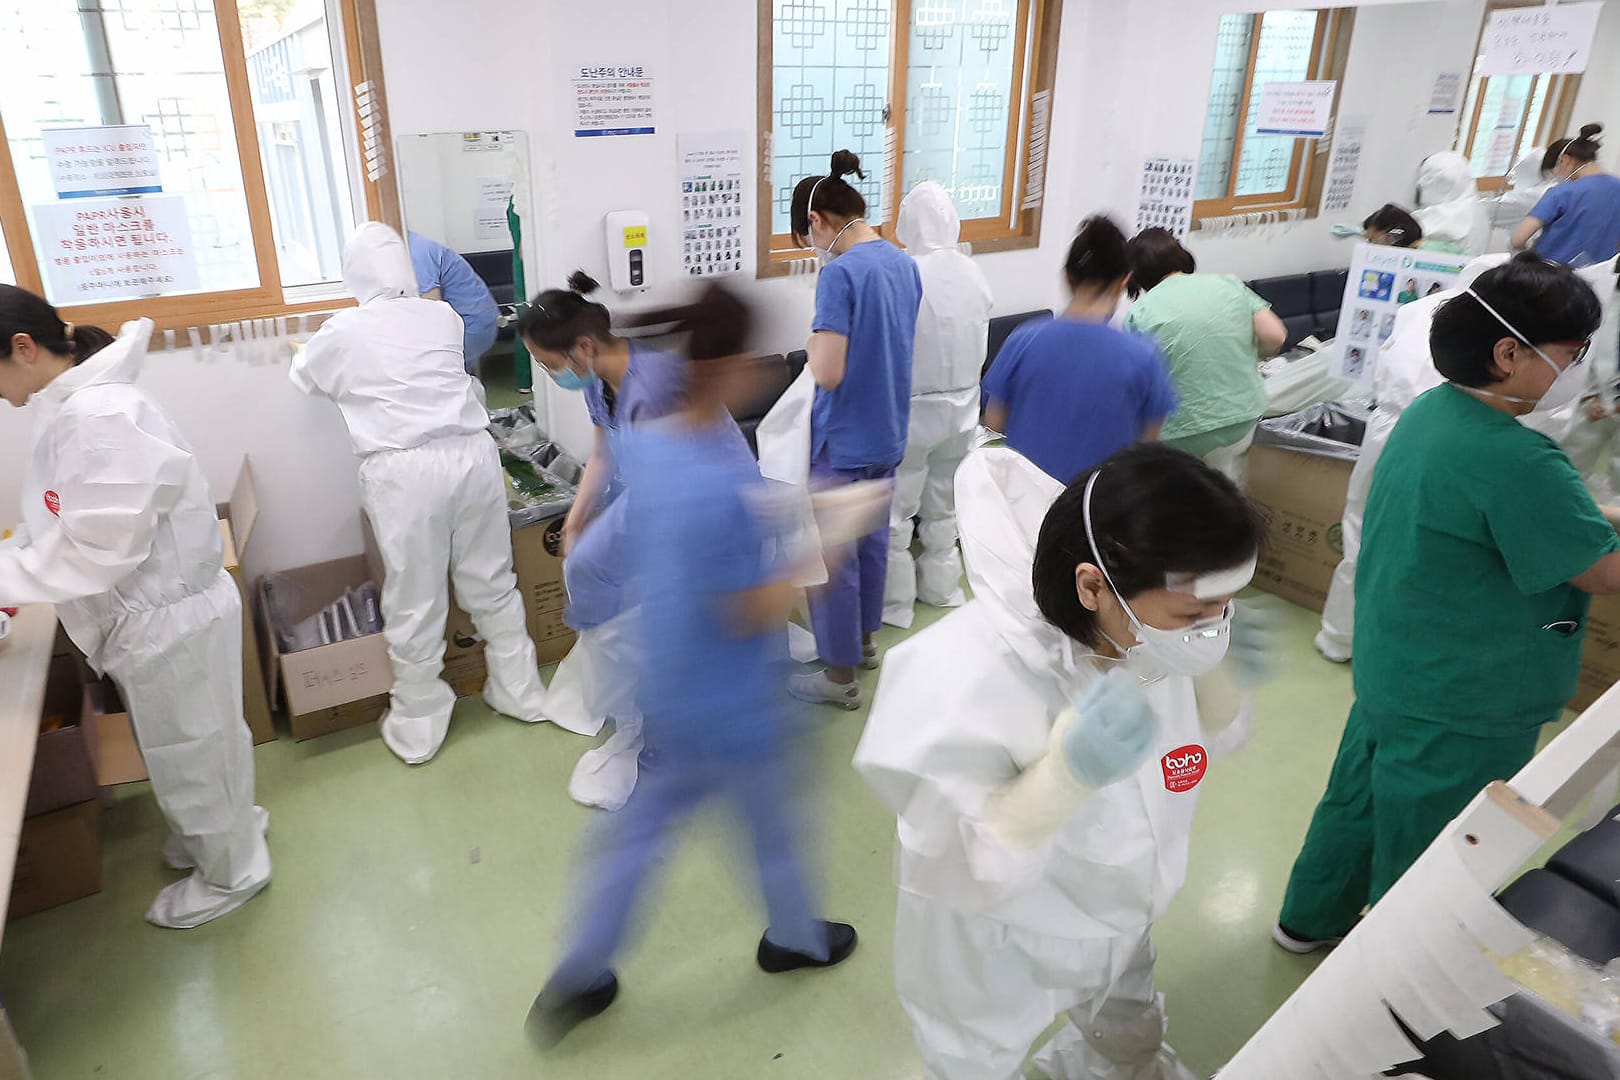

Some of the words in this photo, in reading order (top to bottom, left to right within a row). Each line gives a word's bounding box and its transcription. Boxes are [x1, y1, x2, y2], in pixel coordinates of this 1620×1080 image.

[580, 67, 616, 78] 도난주의
[618, 66, 644, 78] 안내문
[72, 223, 99, 236] 일반
[102, 219, 155, 232] 마스크를
[60, 235, 127, 250] 착용하시면
[1165, 752, 1203, 770] boho
